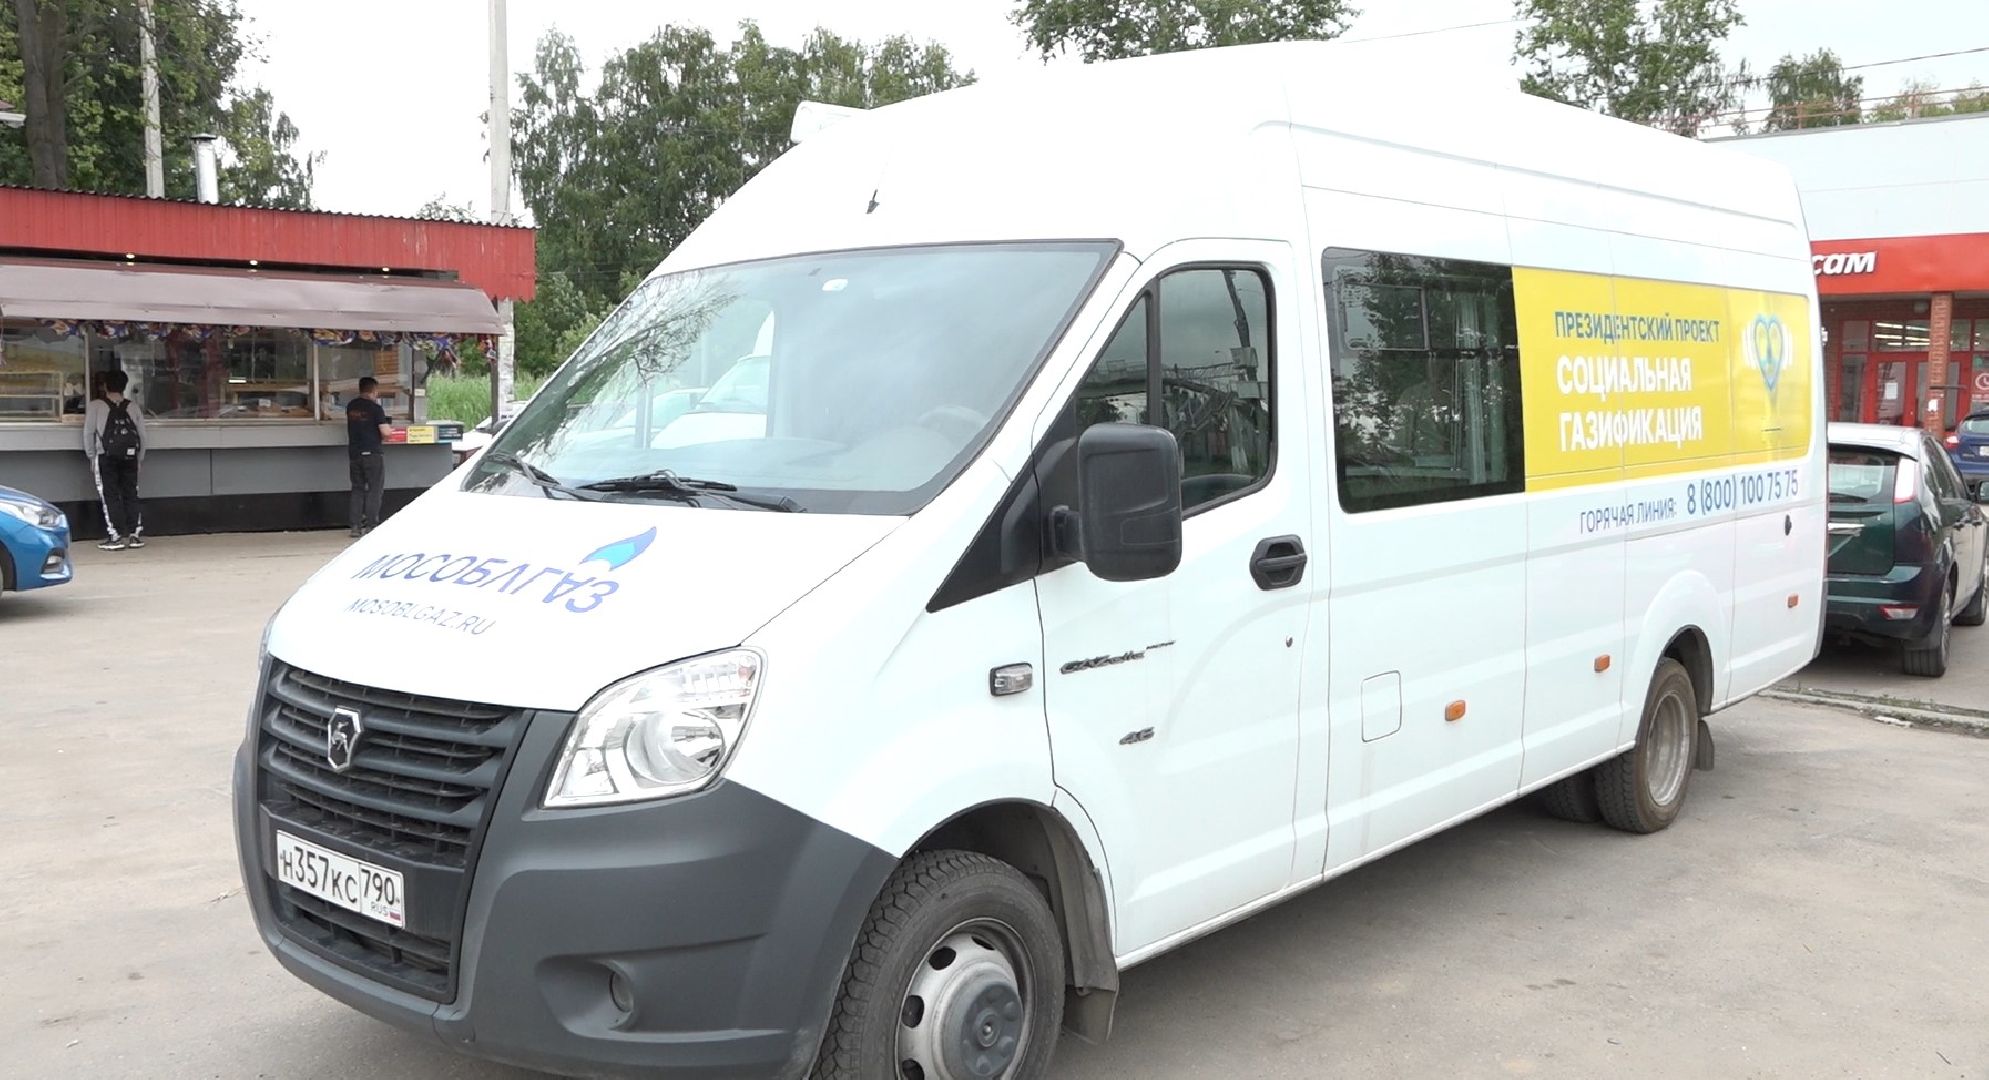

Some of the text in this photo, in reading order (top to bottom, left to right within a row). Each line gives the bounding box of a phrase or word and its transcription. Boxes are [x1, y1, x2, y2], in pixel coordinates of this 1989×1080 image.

[1555, 311, 1720, 344] ПРЕЗИДЕНТСКИЙ ПРОЕКТ
[1556, 355, 1693, 402] СОЦИАЛЬНАЯ
[1559, 405, 1703, 451] ГАЗИФИКАЦИЯ
[1580, 469, 1799, 534] ГОРЯЧАЯ ЛИНИЯ: 8 (800) 100 75 75
[351, 553, 620, 613] МОСОБЛГАЗ
[344, 598, 497, 635] MOSOBLGAZ.RU
